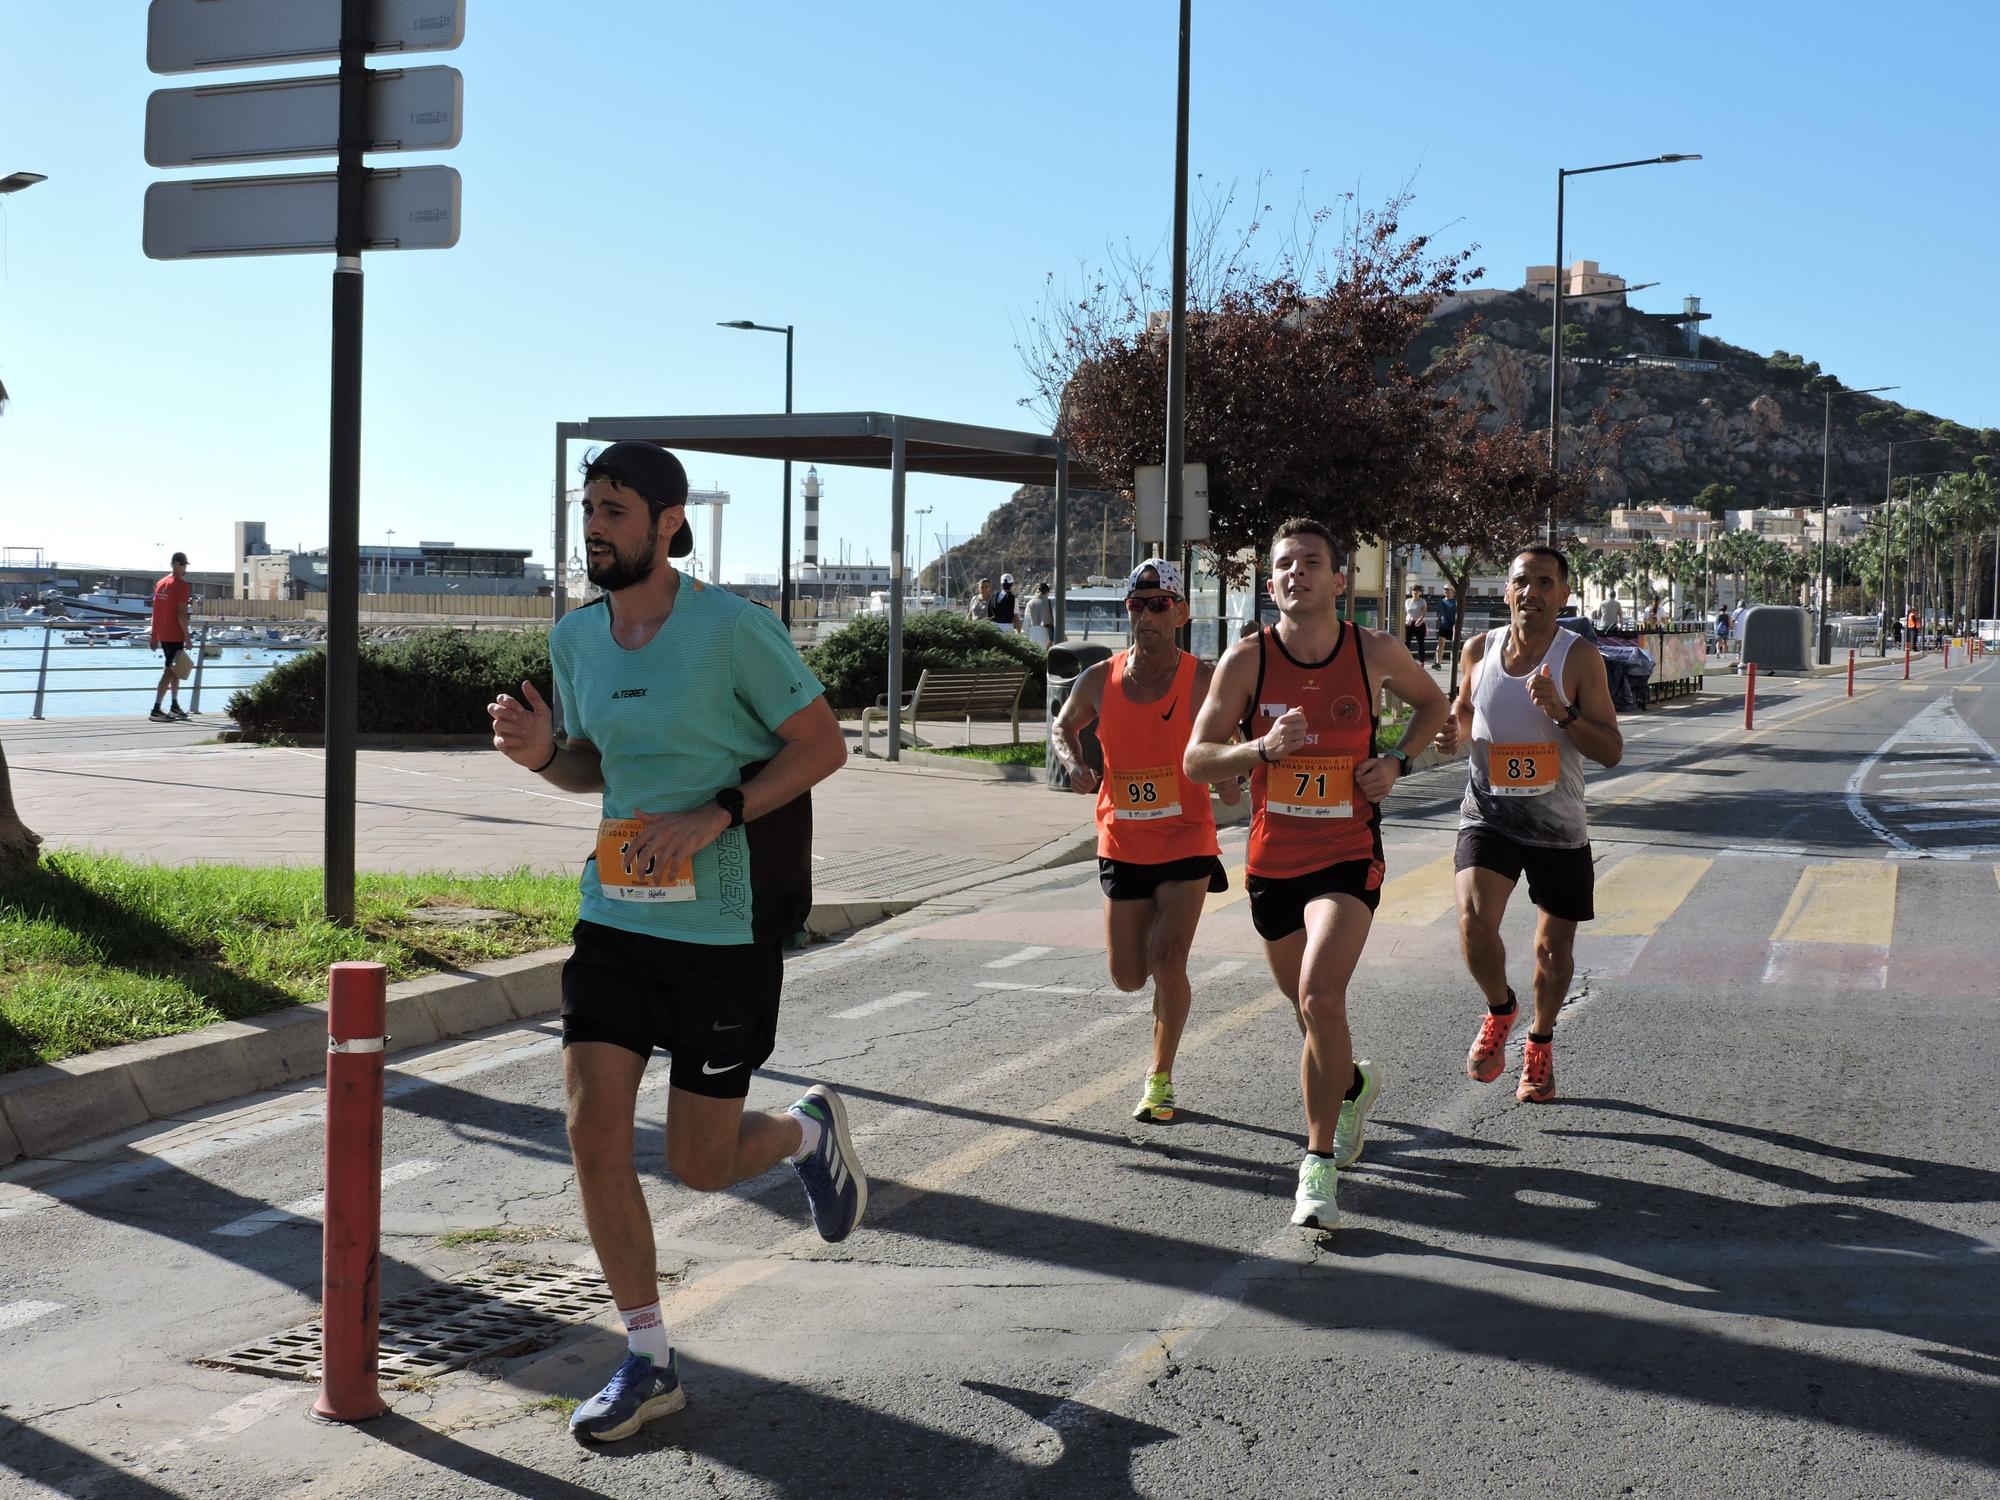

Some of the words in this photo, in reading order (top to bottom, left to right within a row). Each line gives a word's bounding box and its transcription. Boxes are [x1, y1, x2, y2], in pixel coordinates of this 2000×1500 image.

[621, 688, 648, 698] TERREX
[1507, 757, 1537, 780] 83
[1128, 781, 1158, 804] 98
[1294, 772, 1327, 798] 71
[717, 828, 745, 920] ERREX
